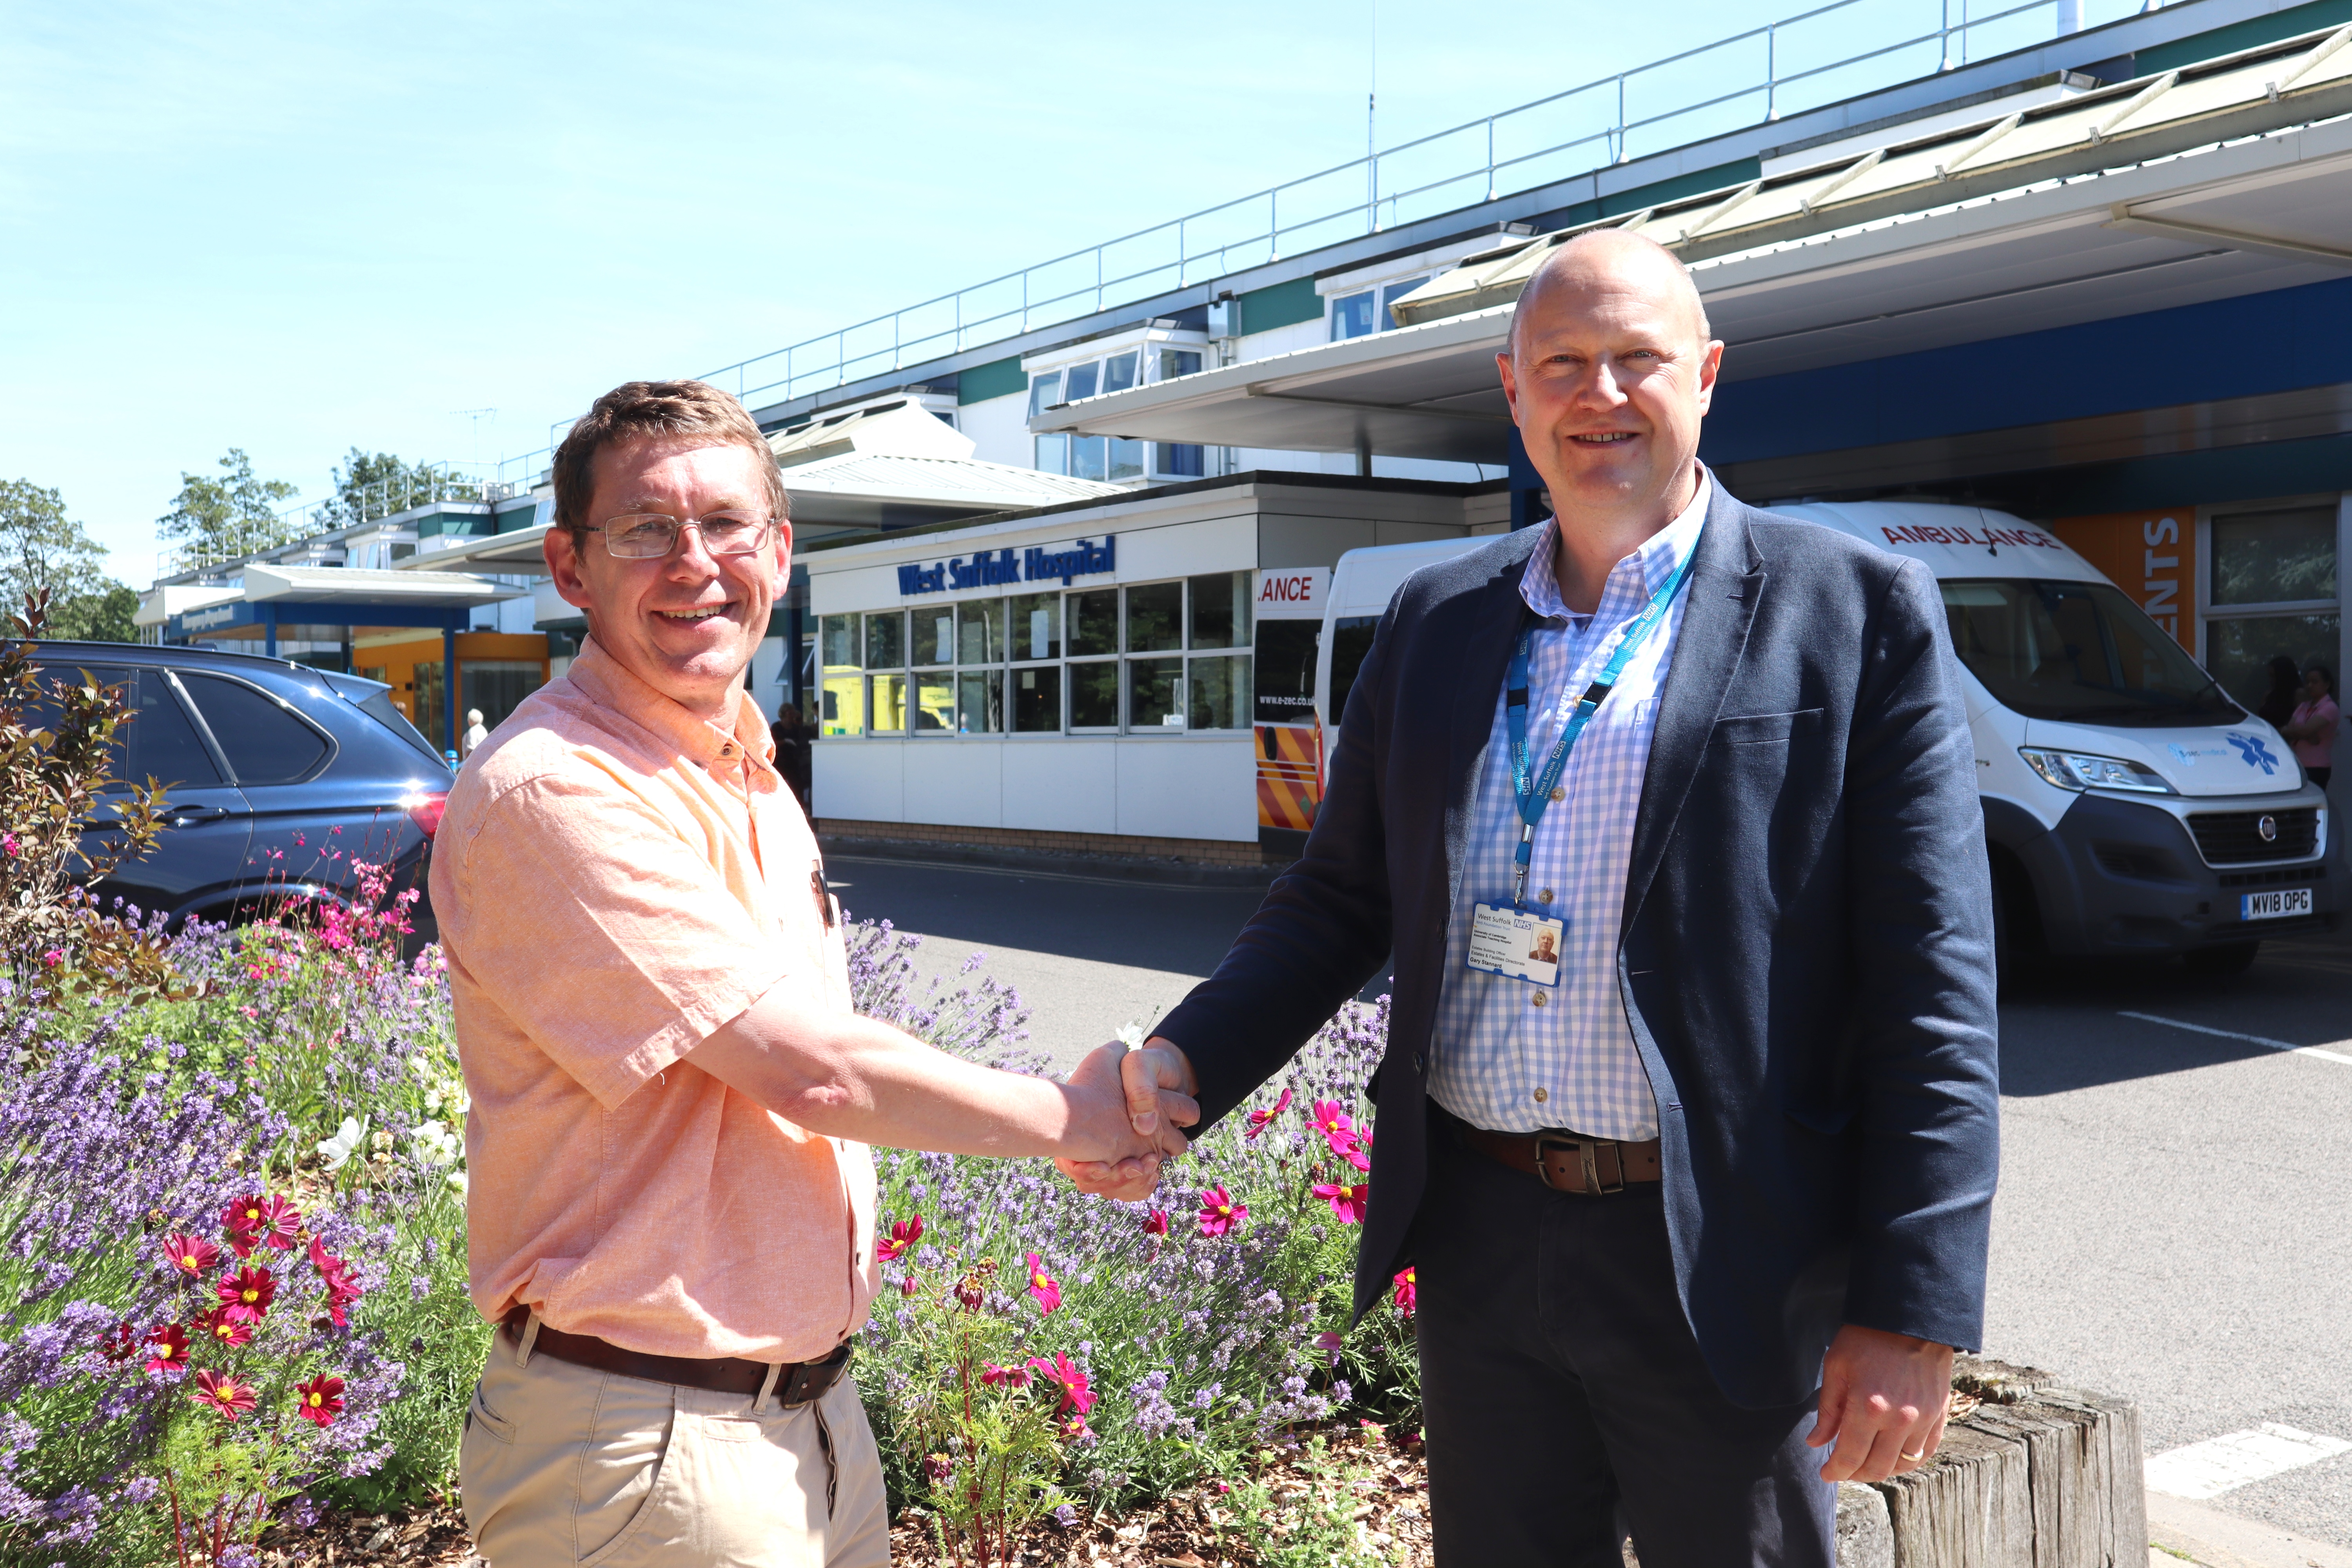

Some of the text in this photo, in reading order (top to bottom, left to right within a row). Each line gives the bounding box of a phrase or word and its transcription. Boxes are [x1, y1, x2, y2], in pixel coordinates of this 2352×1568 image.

[1881, 525, 2063, 550] AMBULANCE
[898, 535, 1116, 595] West Suffolk Hospital
[1258, 577, 1312, 601] ANCE
[1643, 603, 1657, 620] NHS
[1537, 741, 1565, 796] West Suffolk NHS
[2253, 891, 2308, 914] MV18 OPG
[1478, 913, 1512, 926] West Suffolk
[1514, 919, 1531, 929] NHS
[1481, 960, 1502, 968] Stannard
[1505, 958, 1525, 966] Directorate
